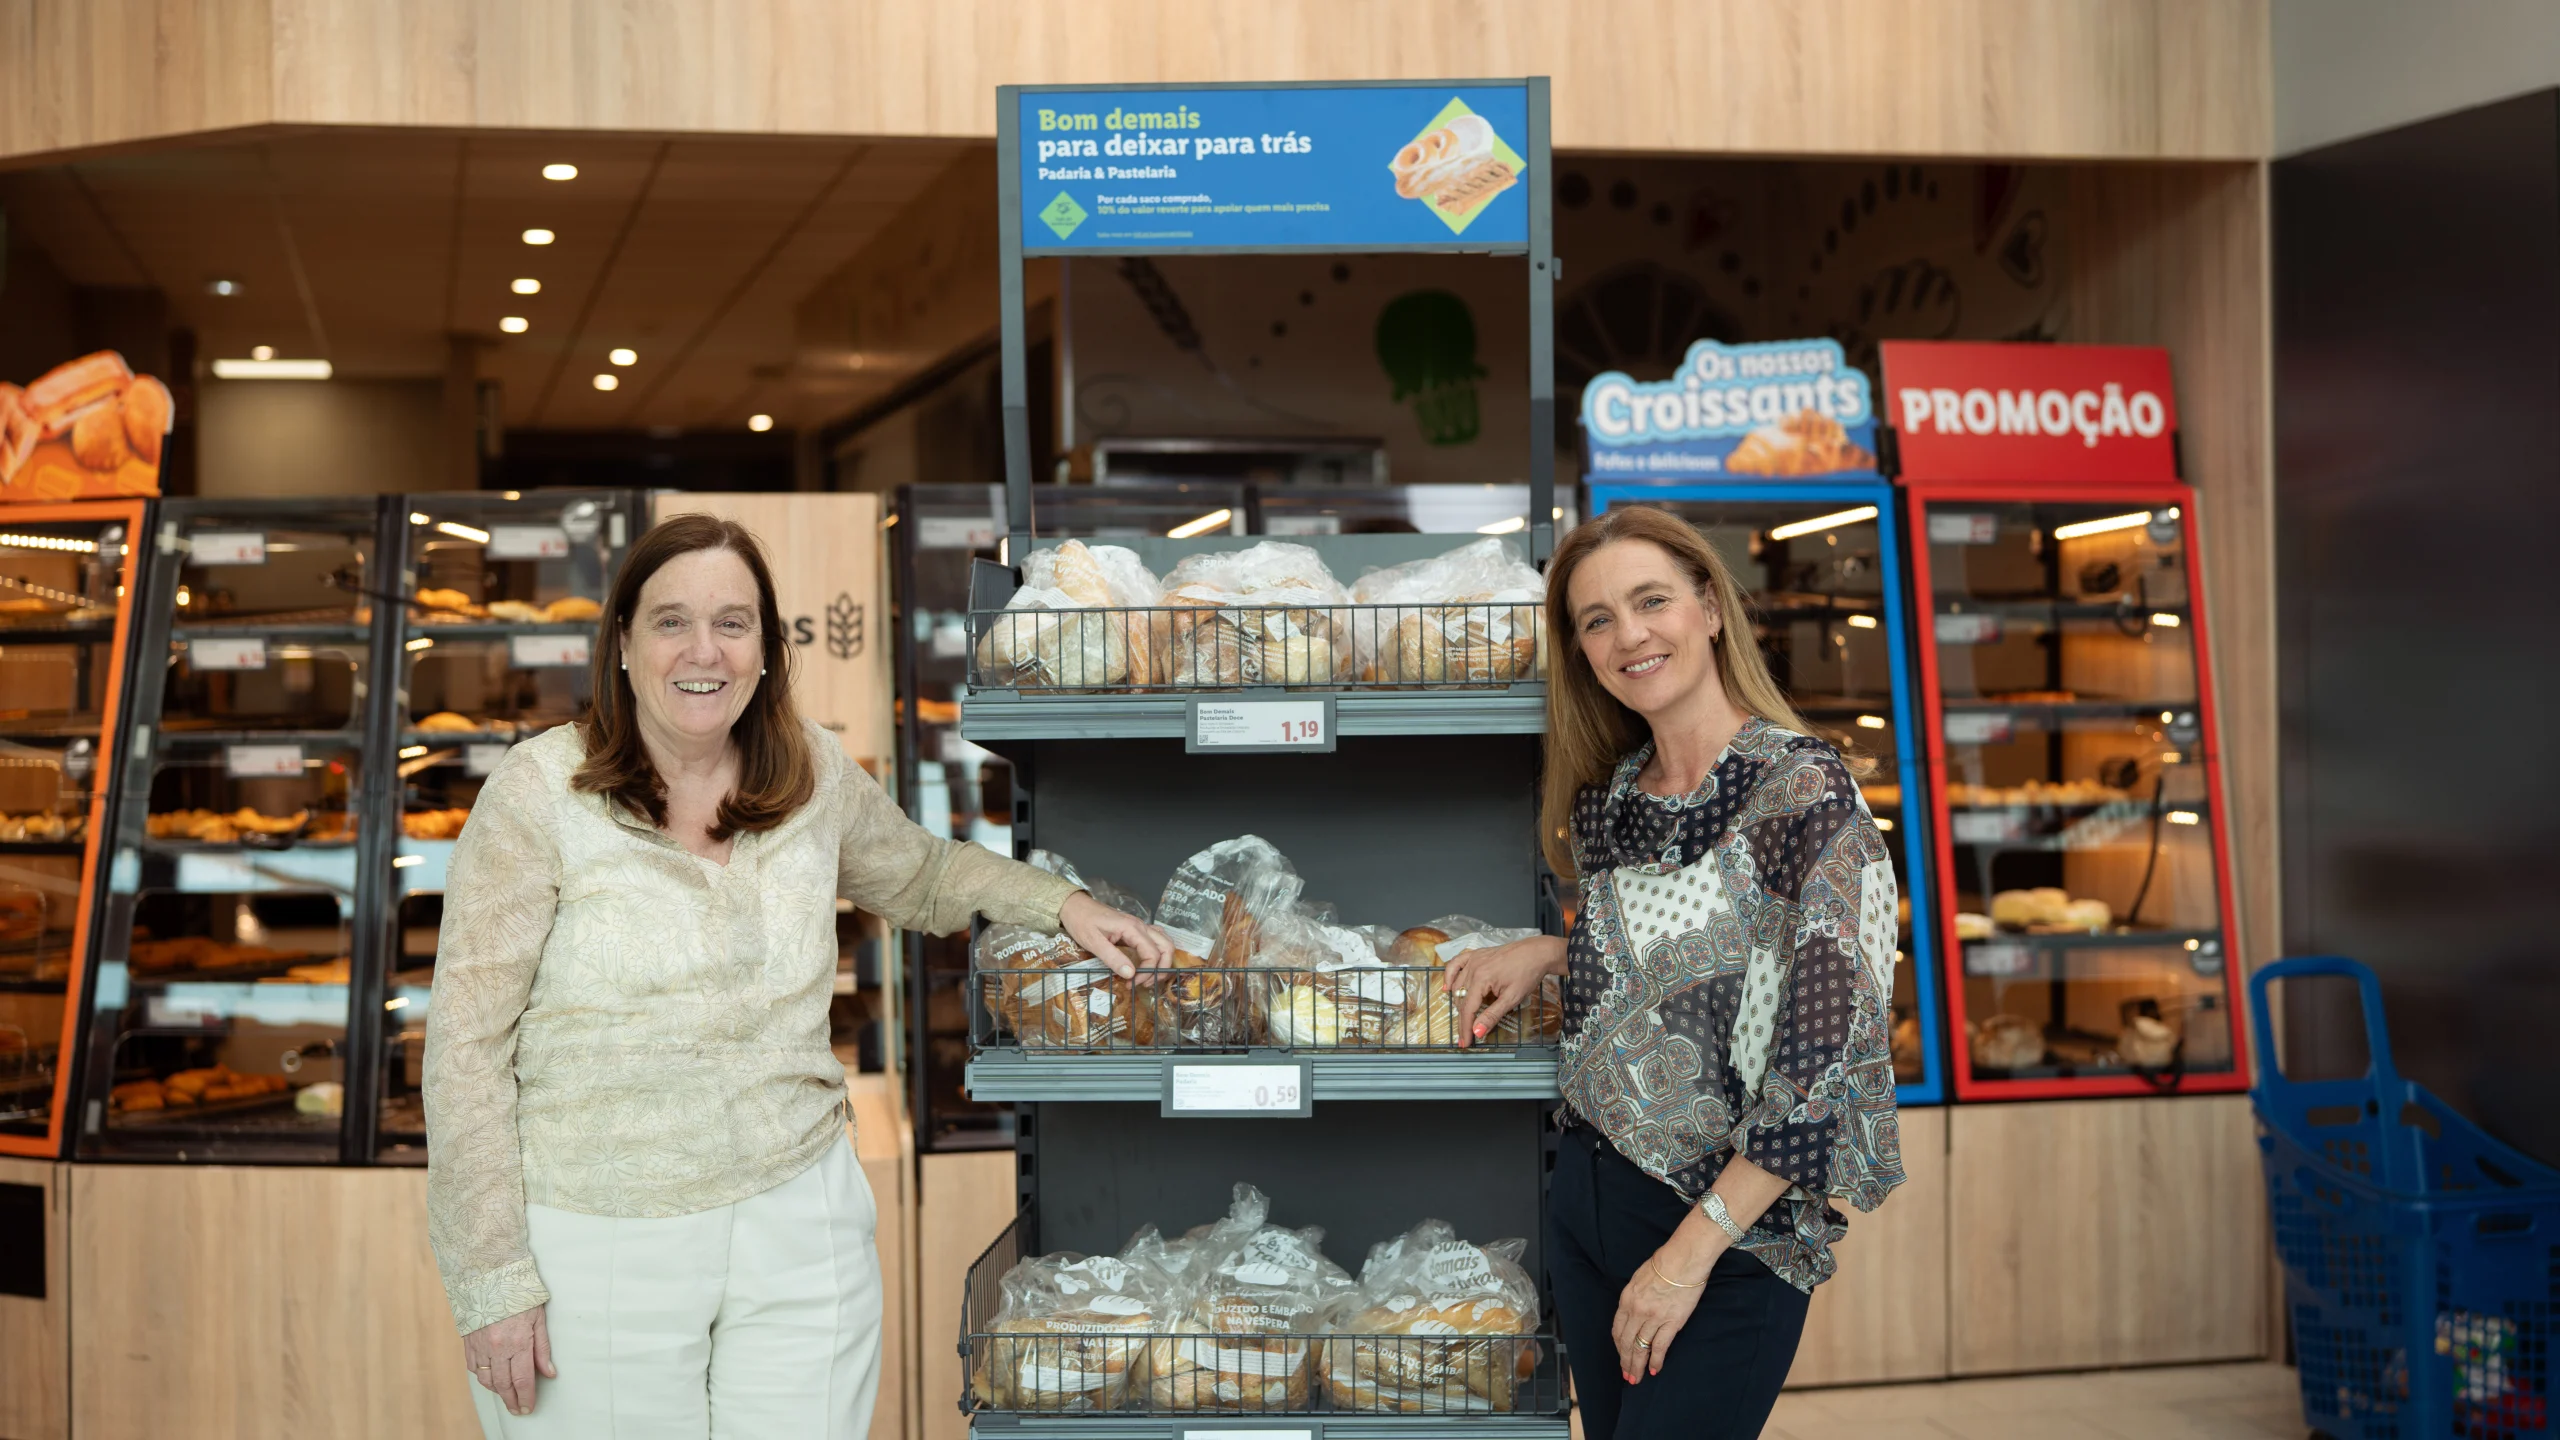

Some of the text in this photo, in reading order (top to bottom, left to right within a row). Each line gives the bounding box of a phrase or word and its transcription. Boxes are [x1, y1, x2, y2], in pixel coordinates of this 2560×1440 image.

[1038, 105, 1201, 131] Bom demais
[1038, 130, 1312, 163] para deixar para trás
[1038, 164, 1177, 180] Padaria & Pastelaria
[1097, 194, 1113, 204] Por
[1115, 193, 1138, 204] cada
[1139, 195, 1161, 204] saco
[1117, 205, 1130, 214] do
[1131, 204, 1155, 214] valor
[1156, 205, 1189, 213] reverte
[1191, 204, 1212, 214] para
[1213, 202, 1243, 215] apoiar
[1244, 203, 1272, 214] quem
[1272, 201, 1295, 212] mais
[1296, 201, 1330, 214] precisa
[1696, 348, 1834, 380] Os nossos
[1594, 374, 1861, 436] Croissants
[1899, 381, 2165, 448] PROMOÇÃO
[1281, 720, 1319, 742] 1.19
[1255, 1086, 1297, 1107] 0.59
